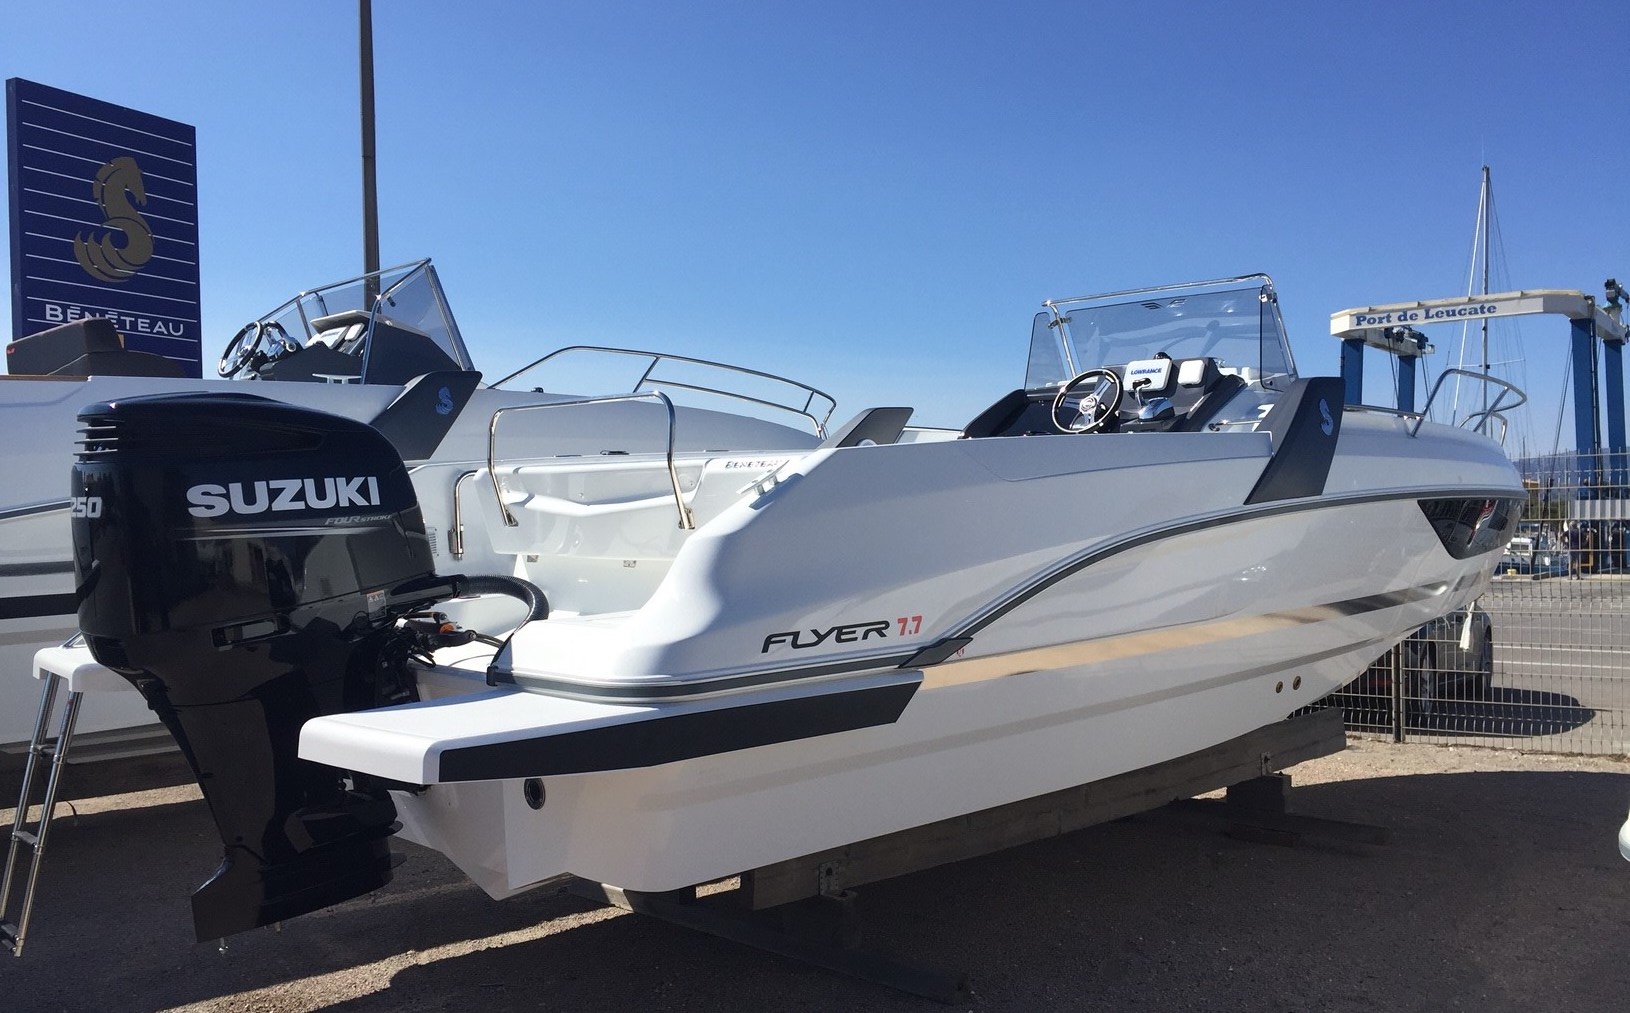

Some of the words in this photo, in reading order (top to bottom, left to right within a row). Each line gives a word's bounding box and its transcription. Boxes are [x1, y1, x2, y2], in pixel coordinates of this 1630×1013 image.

[1355, 313, 1392, 326] Port
[1397, 310, 1418, 322] de
[1424, 303, 1497, 319] Leucate
[1130, 367, 1162, 376] LOWRANCE
[70, 496, 102, 518] 250
[186, 476, 381, 518] SUZUKI
[324, 515, 361, 525] FOUR
[761, 620, 890, 653] FLYER
[897, 615, 922, 637] 7.7
